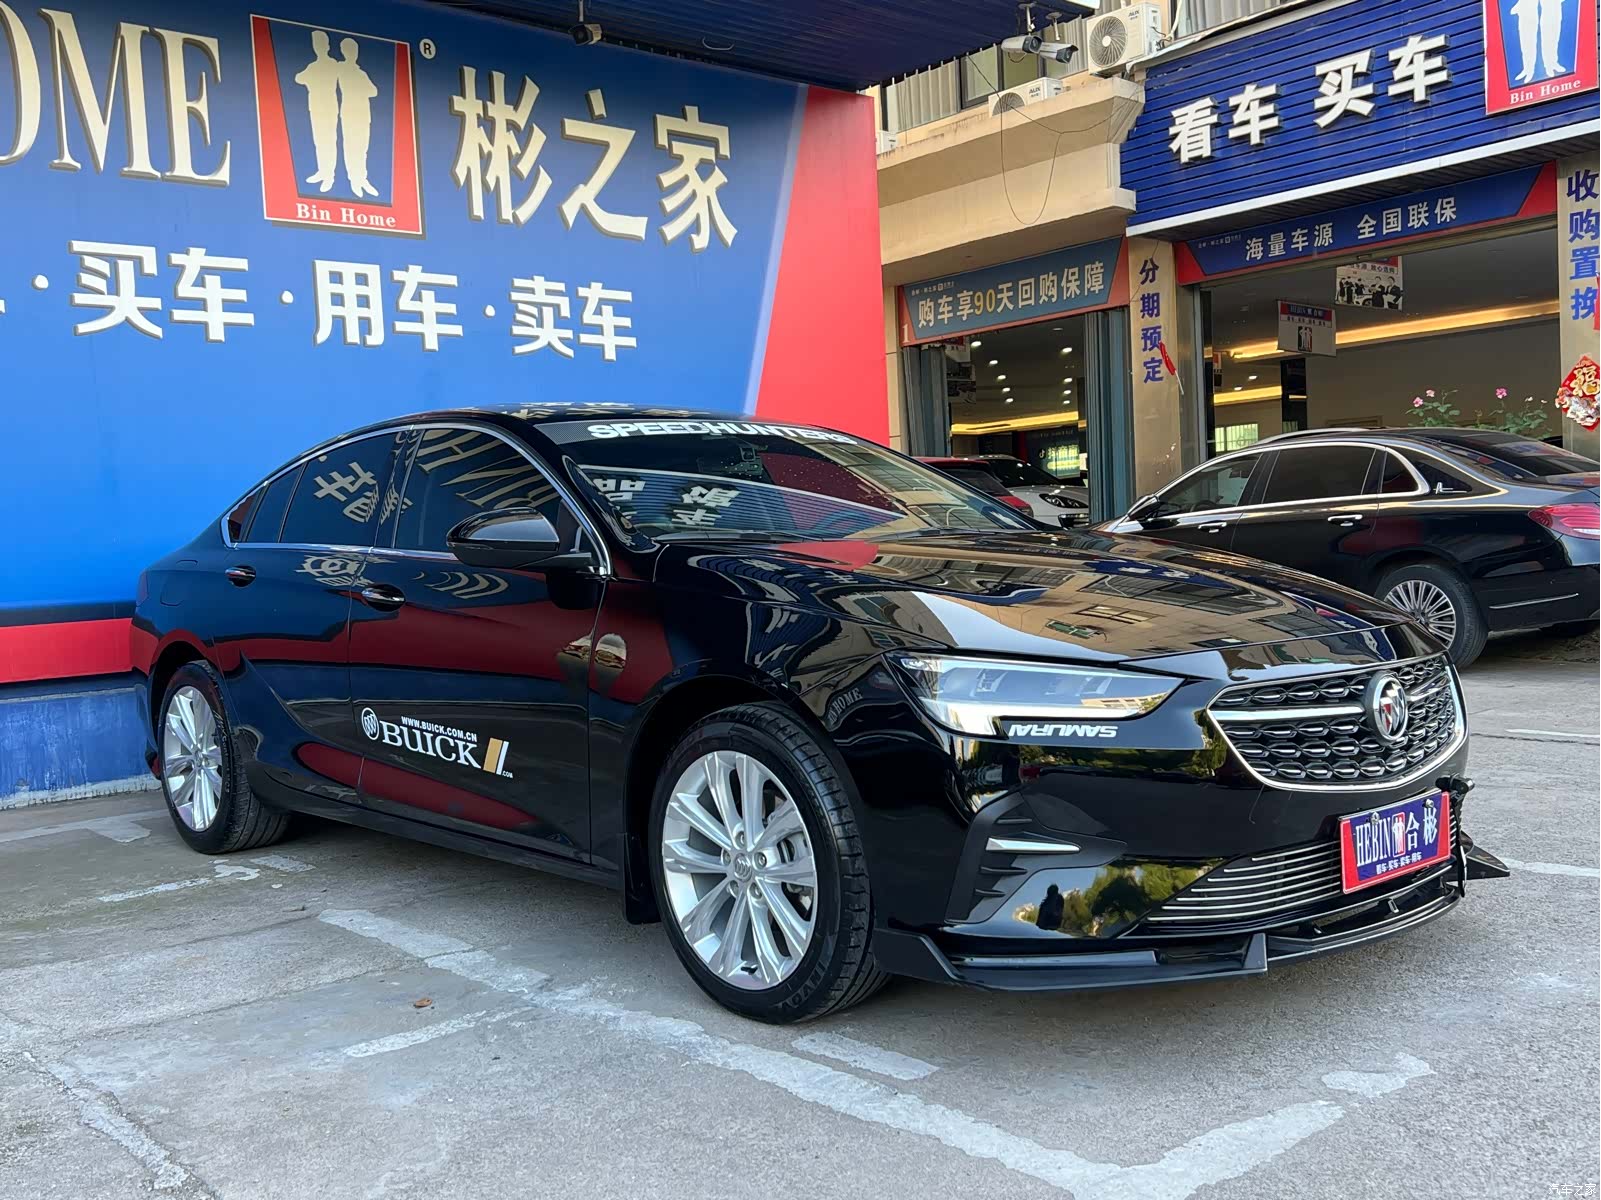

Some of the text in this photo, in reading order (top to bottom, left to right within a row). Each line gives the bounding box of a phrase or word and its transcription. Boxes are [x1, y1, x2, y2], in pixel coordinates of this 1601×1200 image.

[1169, 34, 1453, 164] 看车 买车
[1510, 79, 1581, 105] Bin Home
[449, 66, 738, 252] 彬之家
[295, 203, 397, 228] Bin Home
[1245, 197, 1457, 262] 海量车源 全国联保
[917, 261, 1106, 329] 购车享90天回购保障
[1139, 257, 1164, 384] 分期预定
[587, 421, 858, 446] SPEEDHUNTERS
[379, 720, 482, 769] BUICK
[401, 716, 478, 743] WWW.BUICK.COM.CN
[1008, 724, 1119, 738] SAMURAI
[1355, 816, 1392, 868] HEBIN
[1405, 806, 1438, 851] 合彬
